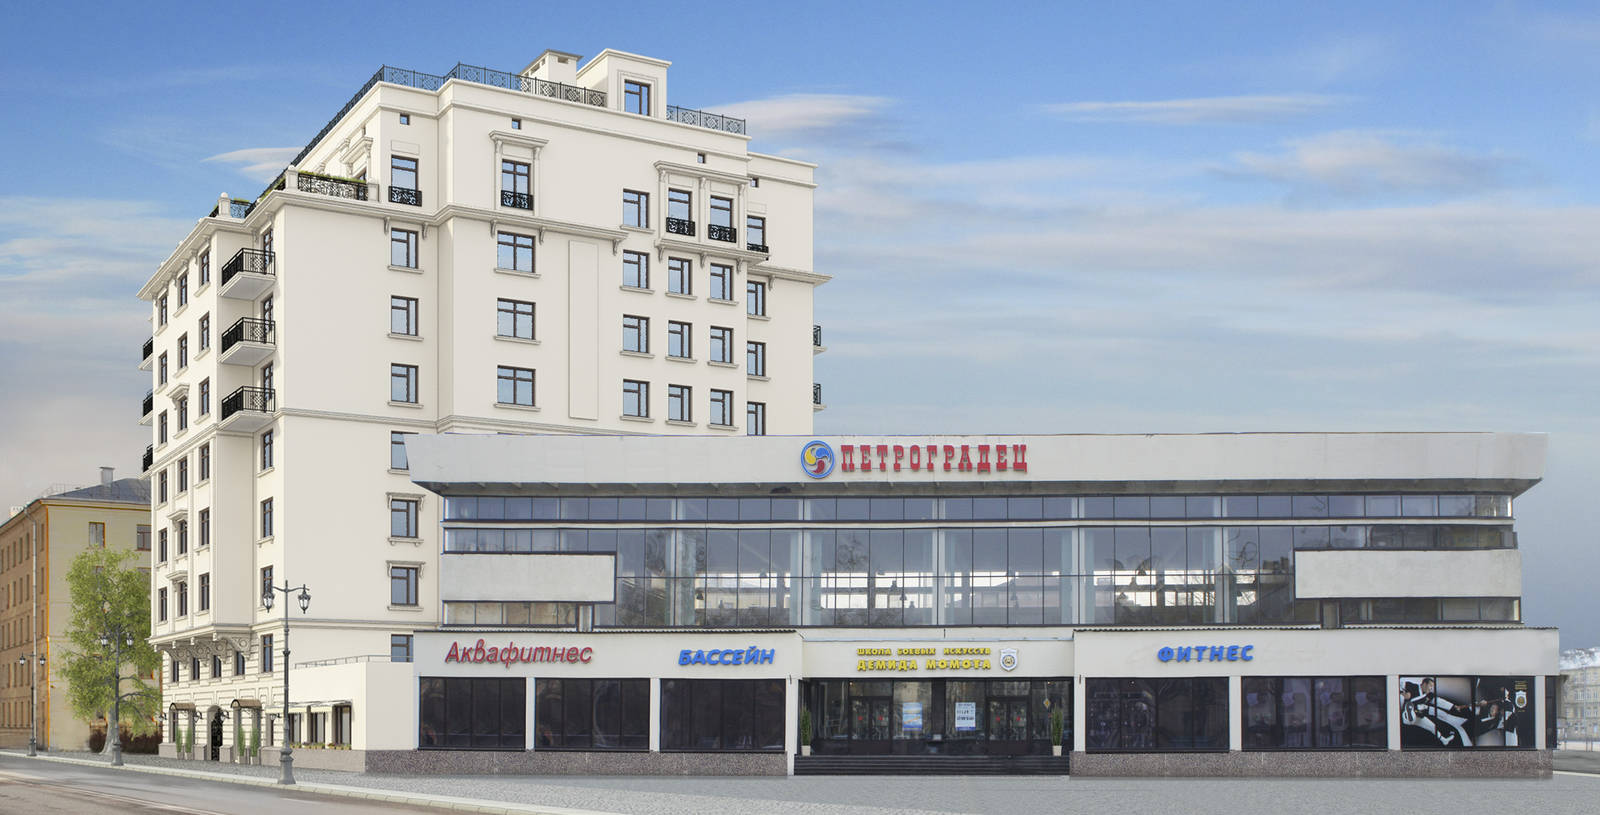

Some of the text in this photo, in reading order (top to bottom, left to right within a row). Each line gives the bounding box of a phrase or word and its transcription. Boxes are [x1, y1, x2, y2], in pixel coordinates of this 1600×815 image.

[841, 444, 1028, 473] ПЕТРОГРАДЕЦ
[445, 639, 593, 667] Аквафитнес
[678, 645, 775, 665] БАССЕЙН
[857, 647, 991, 656] ШКОЛА БОЕВЫХ ИСКУССТВ
[1157, 644, 1254, 662] ФИТНЕС
[857, 659, 991, 672] ДЕМИДА МОМОТА
